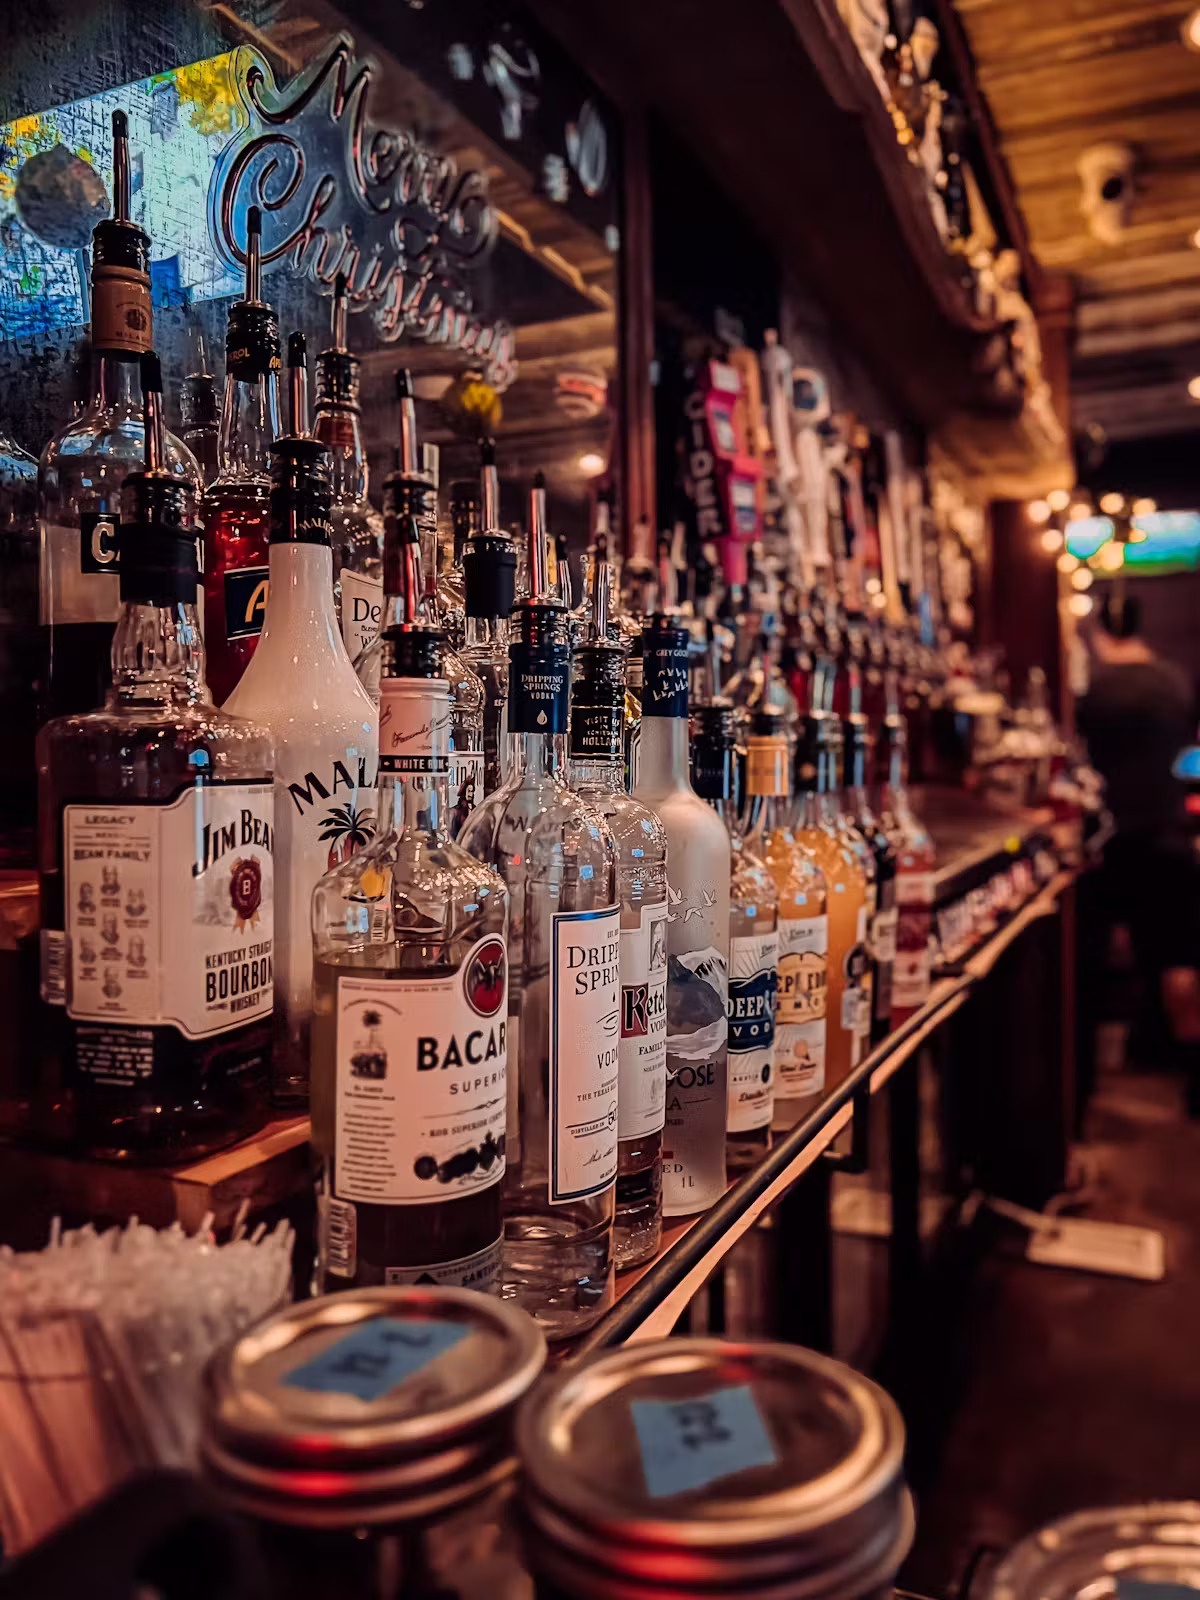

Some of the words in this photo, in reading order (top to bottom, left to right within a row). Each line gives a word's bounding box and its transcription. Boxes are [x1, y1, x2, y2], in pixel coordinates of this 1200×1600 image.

[91, 521, 120, 564] C
[521, 673, 564, 684] DRIPPING
[523, 682, 561, 693] SPRINGS
[531, 691, 555, 700] VODKA
[584, 715, 608, 726] VISIT
[394, 759, 425, 770] WHITE
[428, 759, 445, 770] RUM
[85, 815, 137, 825] LEGACY
[74, 849, 105, 861] BEAM
[107, 850, 152, 863] FAMILY
[192, 821, 237, 880] JIM
[206, 948, 248, 970] KENTUCKY
[230, 991, 260, 1014] WHISKEY
[623, 984, 667, 1032] Ketel
[639, 1042, 662, 1056] FAMILY
[577, 1091, 592, 1102] THE
[594, 1085, 610, 1099] TEXAS
[571, 1123, 599, 1135] DISTILLED
